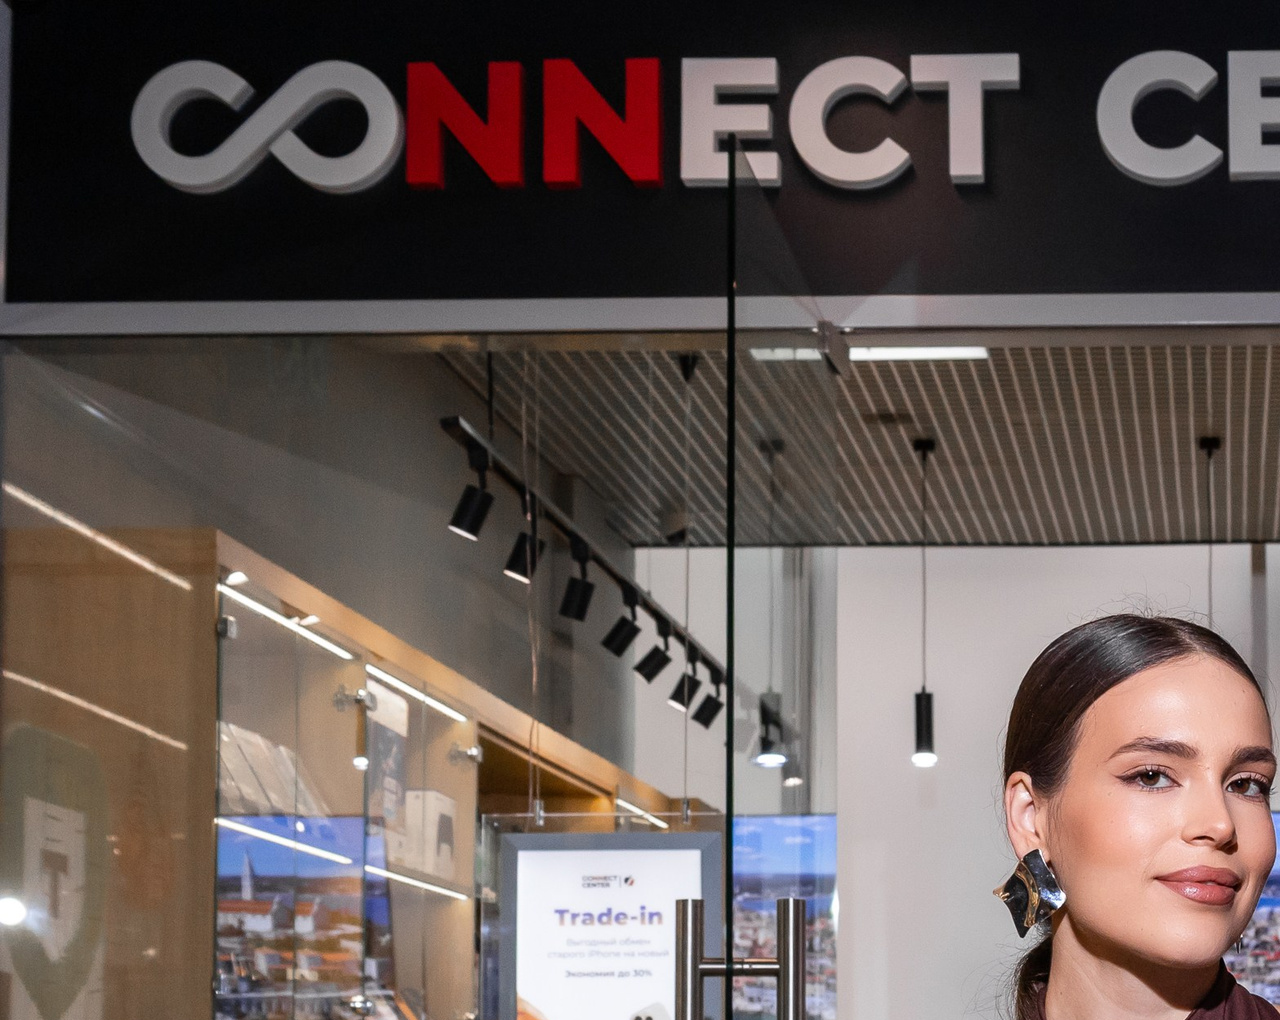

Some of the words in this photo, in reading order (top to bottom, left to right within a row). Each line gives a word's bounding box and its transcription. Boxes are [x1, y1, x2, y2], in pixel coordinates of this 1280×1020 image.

[130, 53, 1020, 194] CONNECT
[554, 906, 664, 926] Trade-in
[566, 938, 617, 947] Выгодный
[618, 937, 651, 946] обмен
[547, 950, 586, 959] старого
[588, 949, 622, 958] iPhone
[637, 950, 670, 958] новый
[564, 970, 616, 978] Экономия
[617, 971, 631, 979] до
[632, 969, 653, 977] 30%
